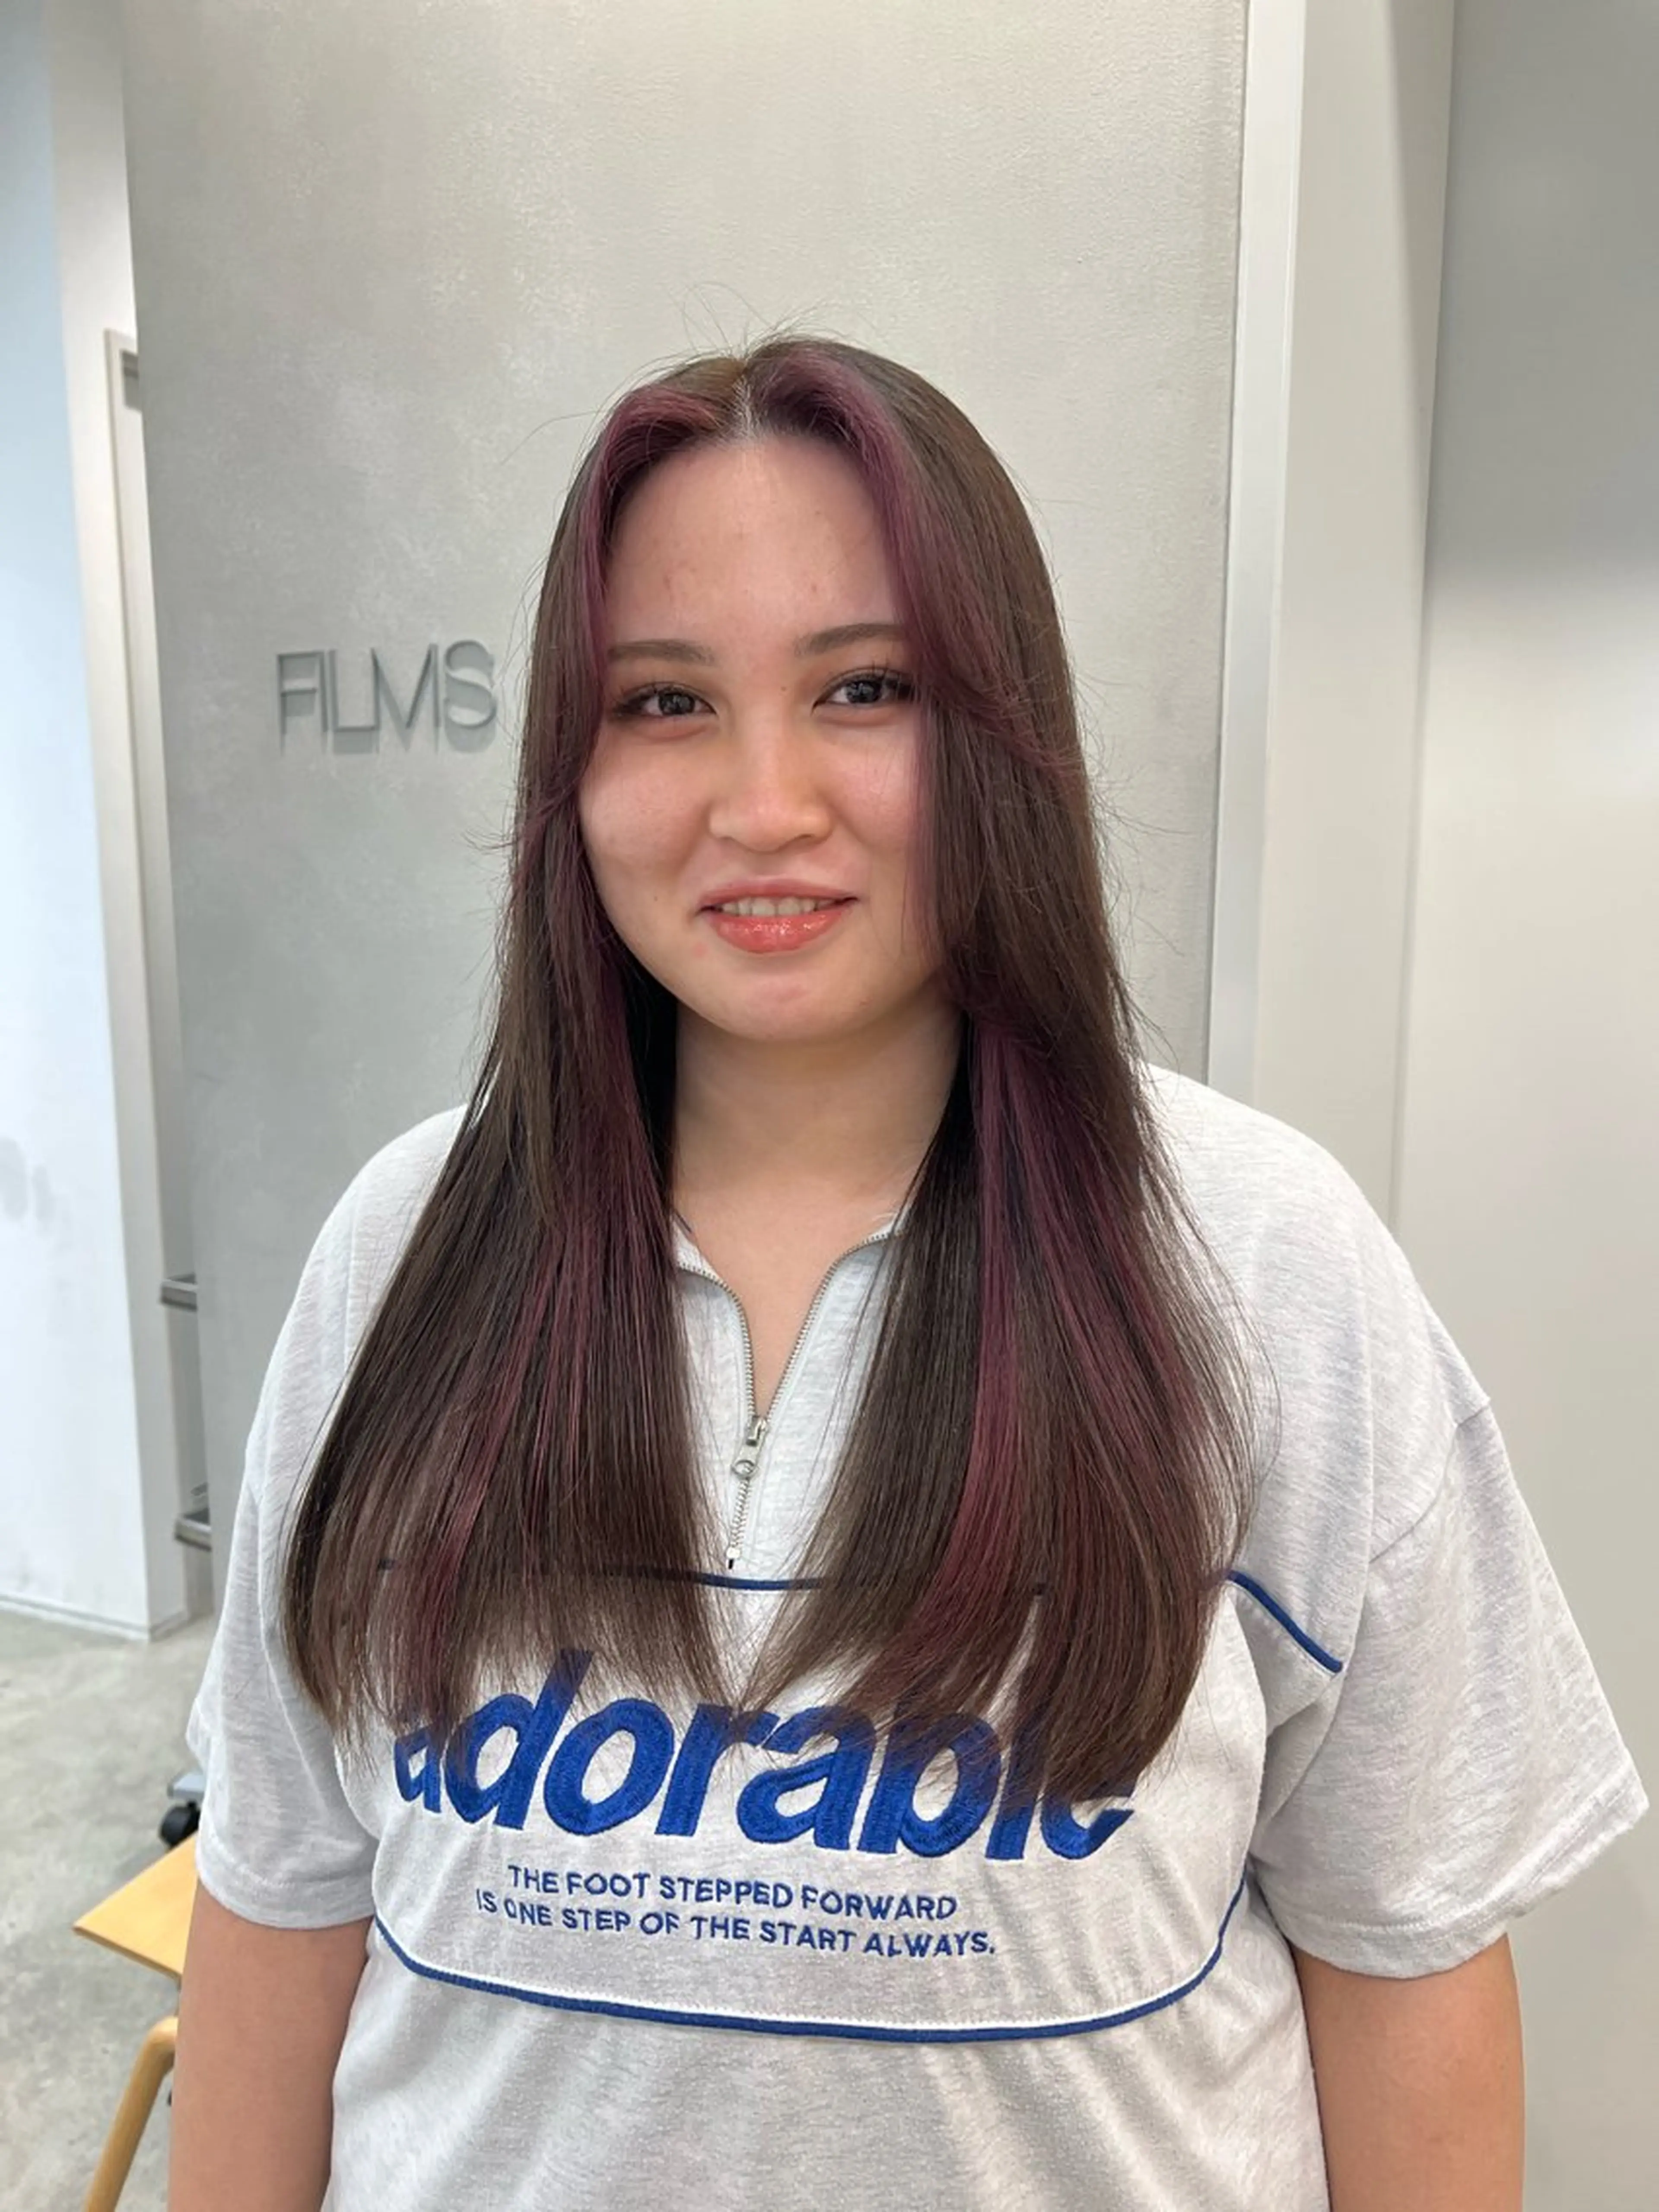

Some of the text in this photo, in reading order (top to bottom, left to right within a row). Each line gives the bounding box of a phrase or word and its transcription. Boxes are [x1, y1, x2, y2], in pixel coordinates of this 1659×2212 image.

[277, 640, 497, 737] FILMS
[476, 1889, 996, 1958] IS ONE STEP OF THE START ALWAYS.
[508, 1865, 957, 1921] THE FOOT STEPPED FORWARD
